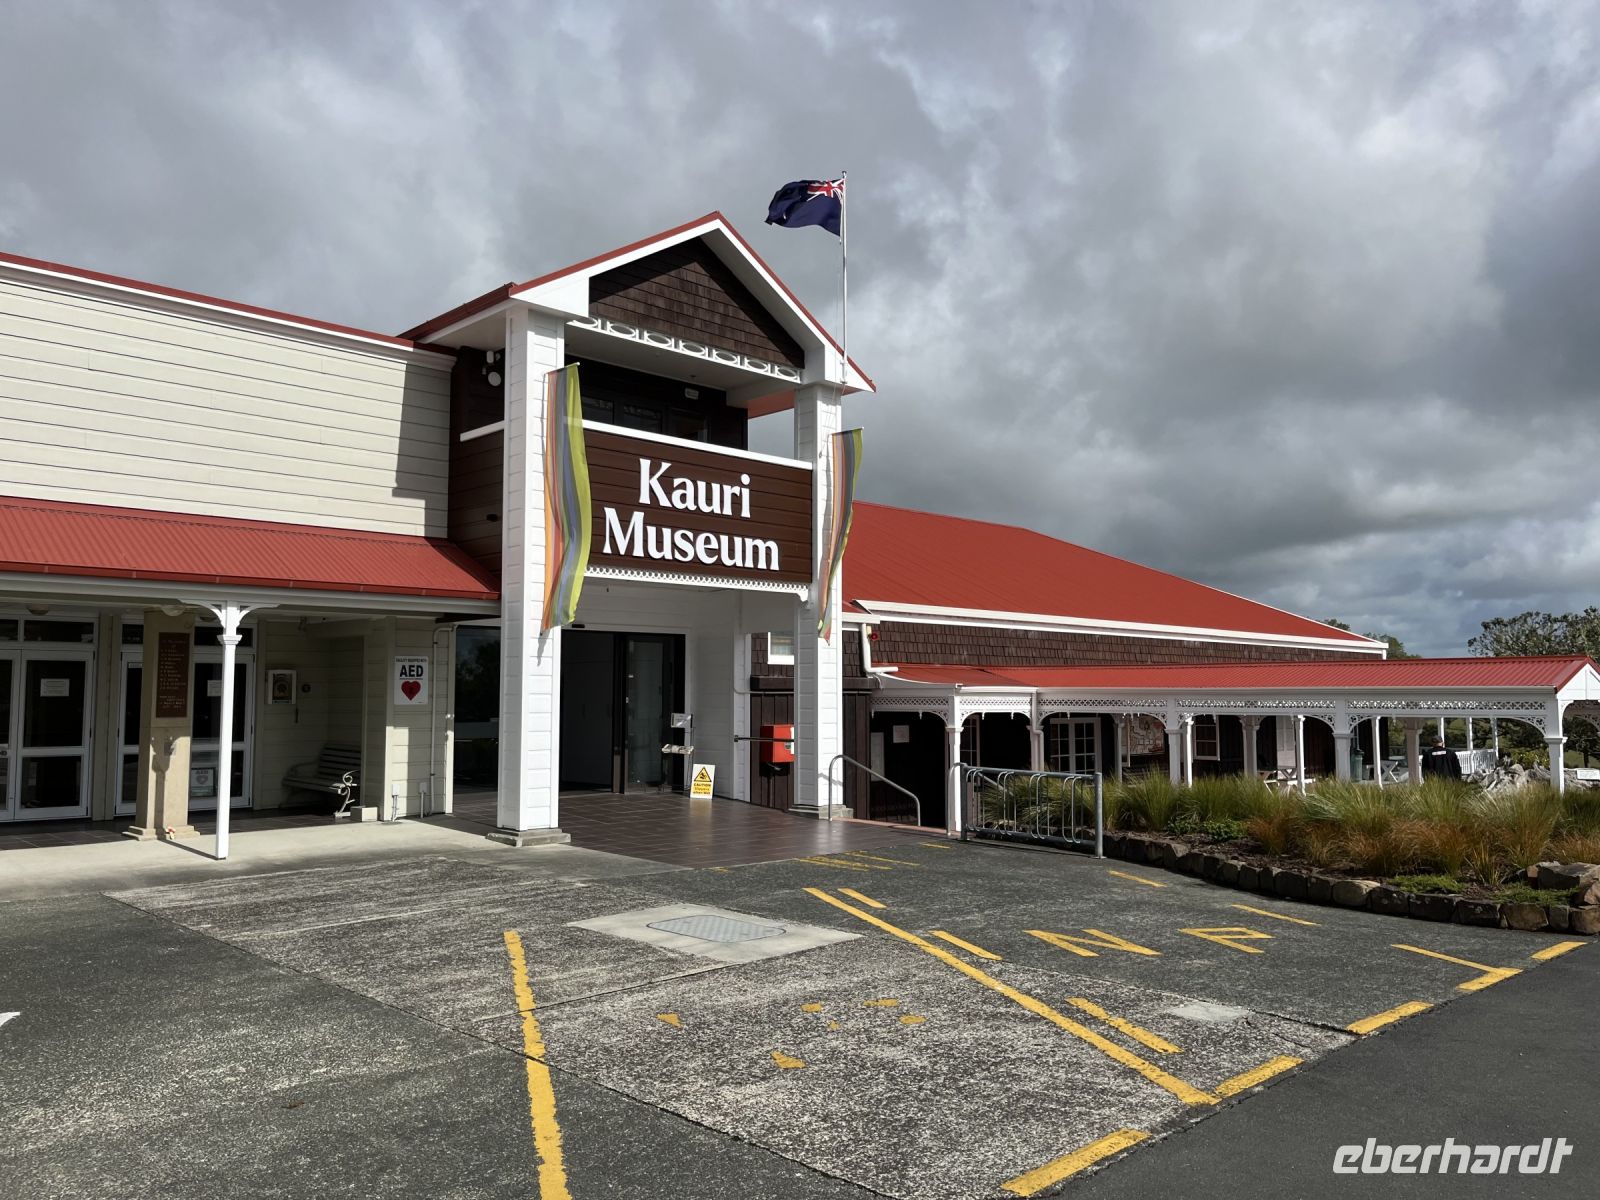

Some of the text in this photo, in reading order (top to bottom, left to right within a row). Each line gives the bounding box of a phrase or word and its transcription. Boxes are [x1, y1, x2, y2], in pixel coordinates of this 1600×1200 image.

[639, 458, 750, 518] Kauri
[602, 507, 779, 571] Museum
[399, 665, 424, 677] AED
